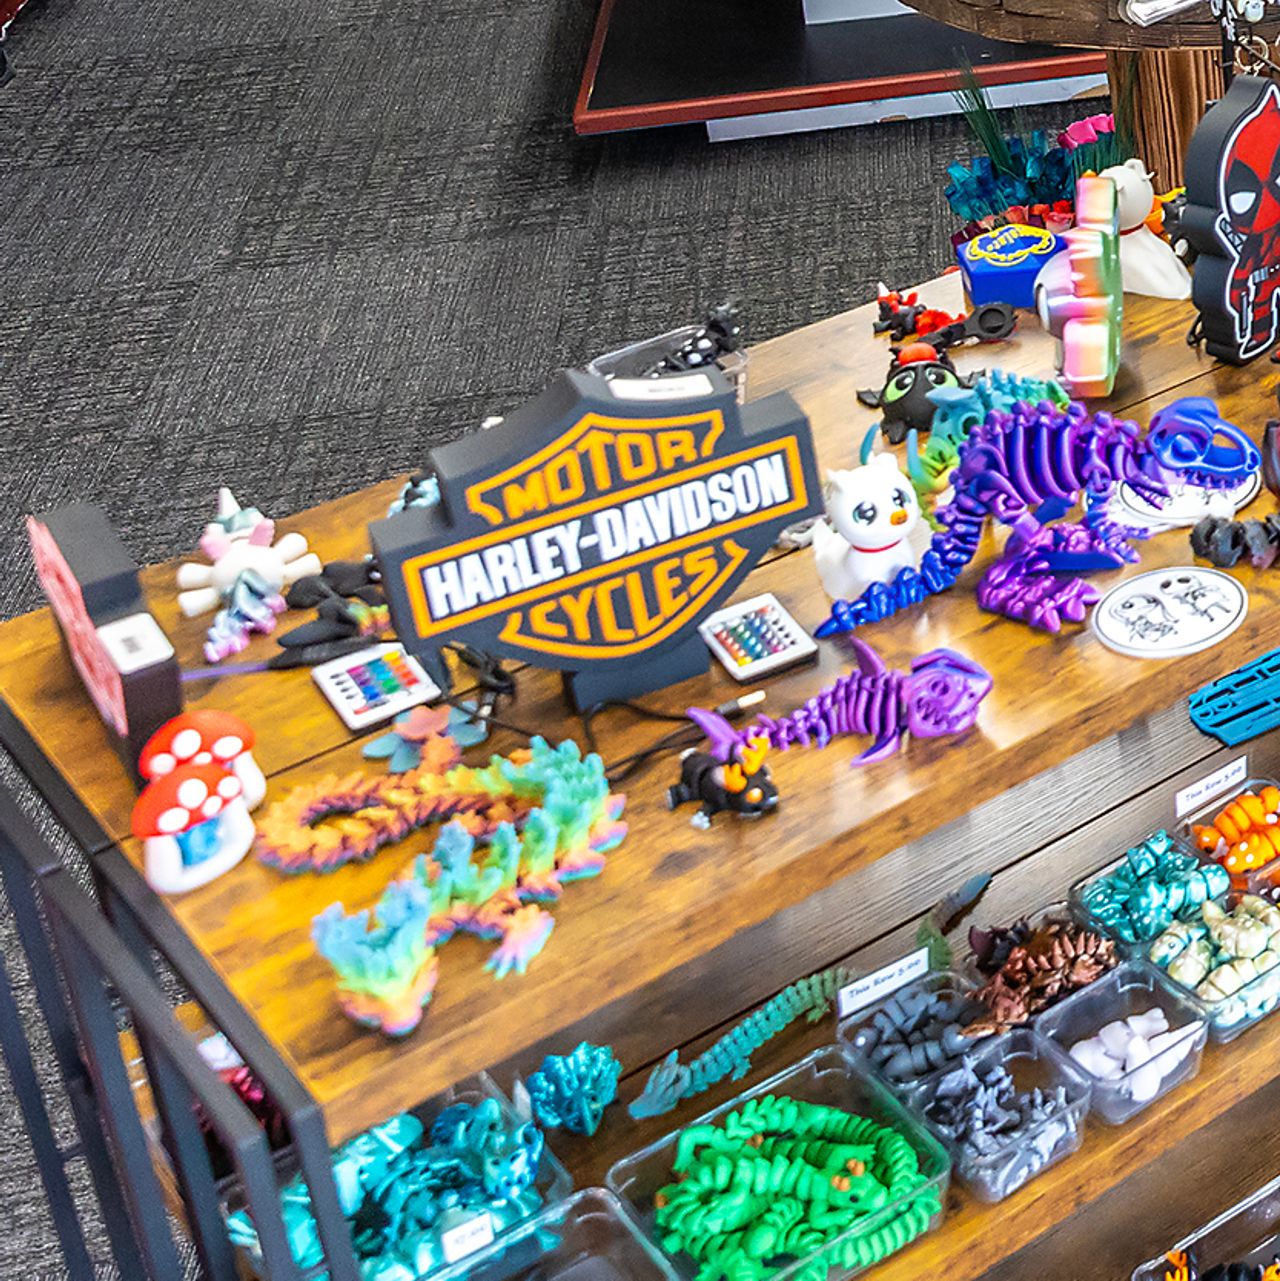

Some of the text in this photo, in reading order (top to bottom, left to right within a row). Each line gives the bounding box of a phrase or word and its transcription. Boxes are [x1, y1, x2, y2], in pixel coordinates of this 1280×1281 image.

[504, 429, 696, 518] MOTOR
[422, 453, 790, 621] HARLEY-DAVIDSON
[530, 546, 718, 642] CYCLES
[1185, 789, 1203, 801] This
[1205, 778, 1223, 791] Row
[848, 985, 870, 998] This
[873, 971, 896, 986] Row
